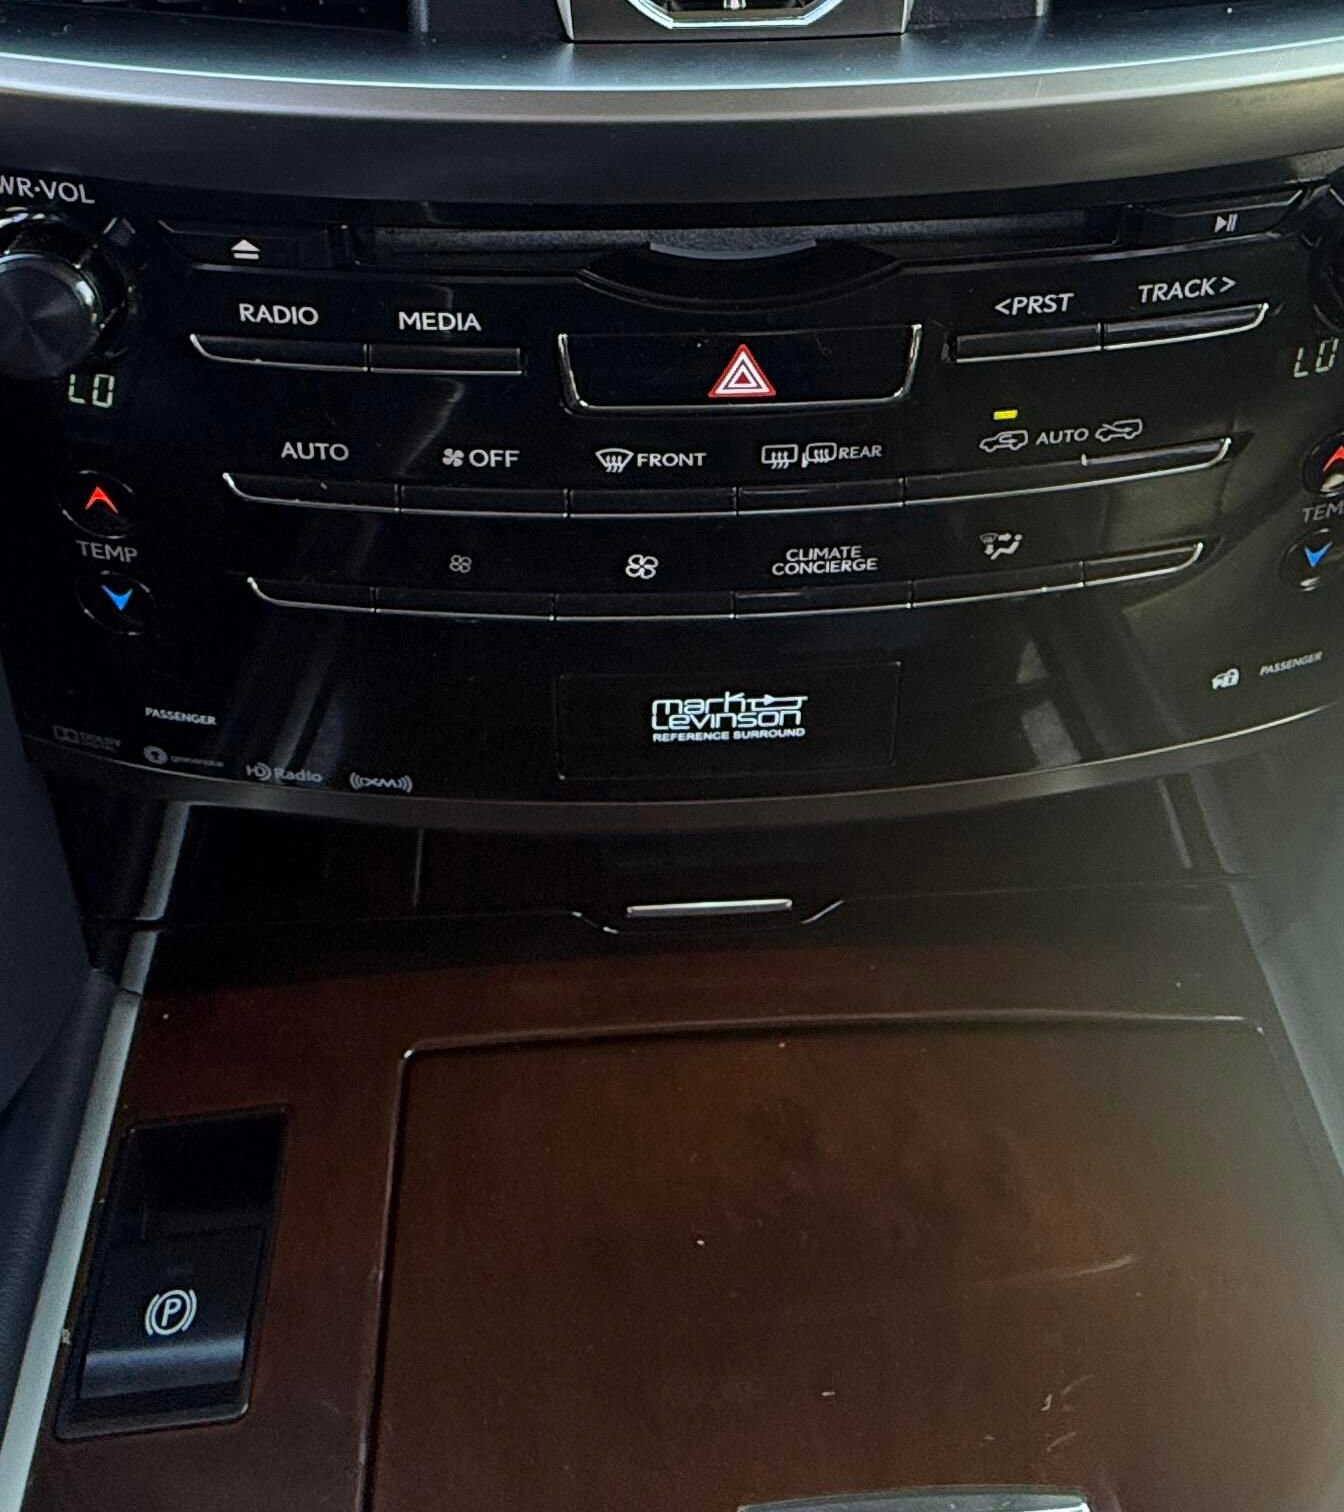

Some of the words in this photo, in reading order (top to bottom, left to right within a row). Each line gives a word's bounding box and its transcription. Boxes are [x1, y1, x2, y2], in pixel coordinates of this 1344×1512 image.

[237, 302, 320, 327] RADIO
[397, 310, 483, 333] MEDIA
[1035, 426, 1090, 447] AUTO
[280, 440, 350, 462] AUTO
[468, 447, 521, 469] OFF
[636, 450, 706, 468] FRONT
[838, 444, 882, 460] REAR
[75, 539, 138, 564] TEMP
[785, 546, 862, 562] CLIMATE
[771, 557, 878, 575] CONCIERGE
[1259, 651, 1324, 676] PASSENGER
[144, 706, 217, 726] PASSENGER
[652, 730, 731, 744] REFERENCE
[732, 727, 807, 740] SURROUND
[273, 767, 324, 784] Radio
